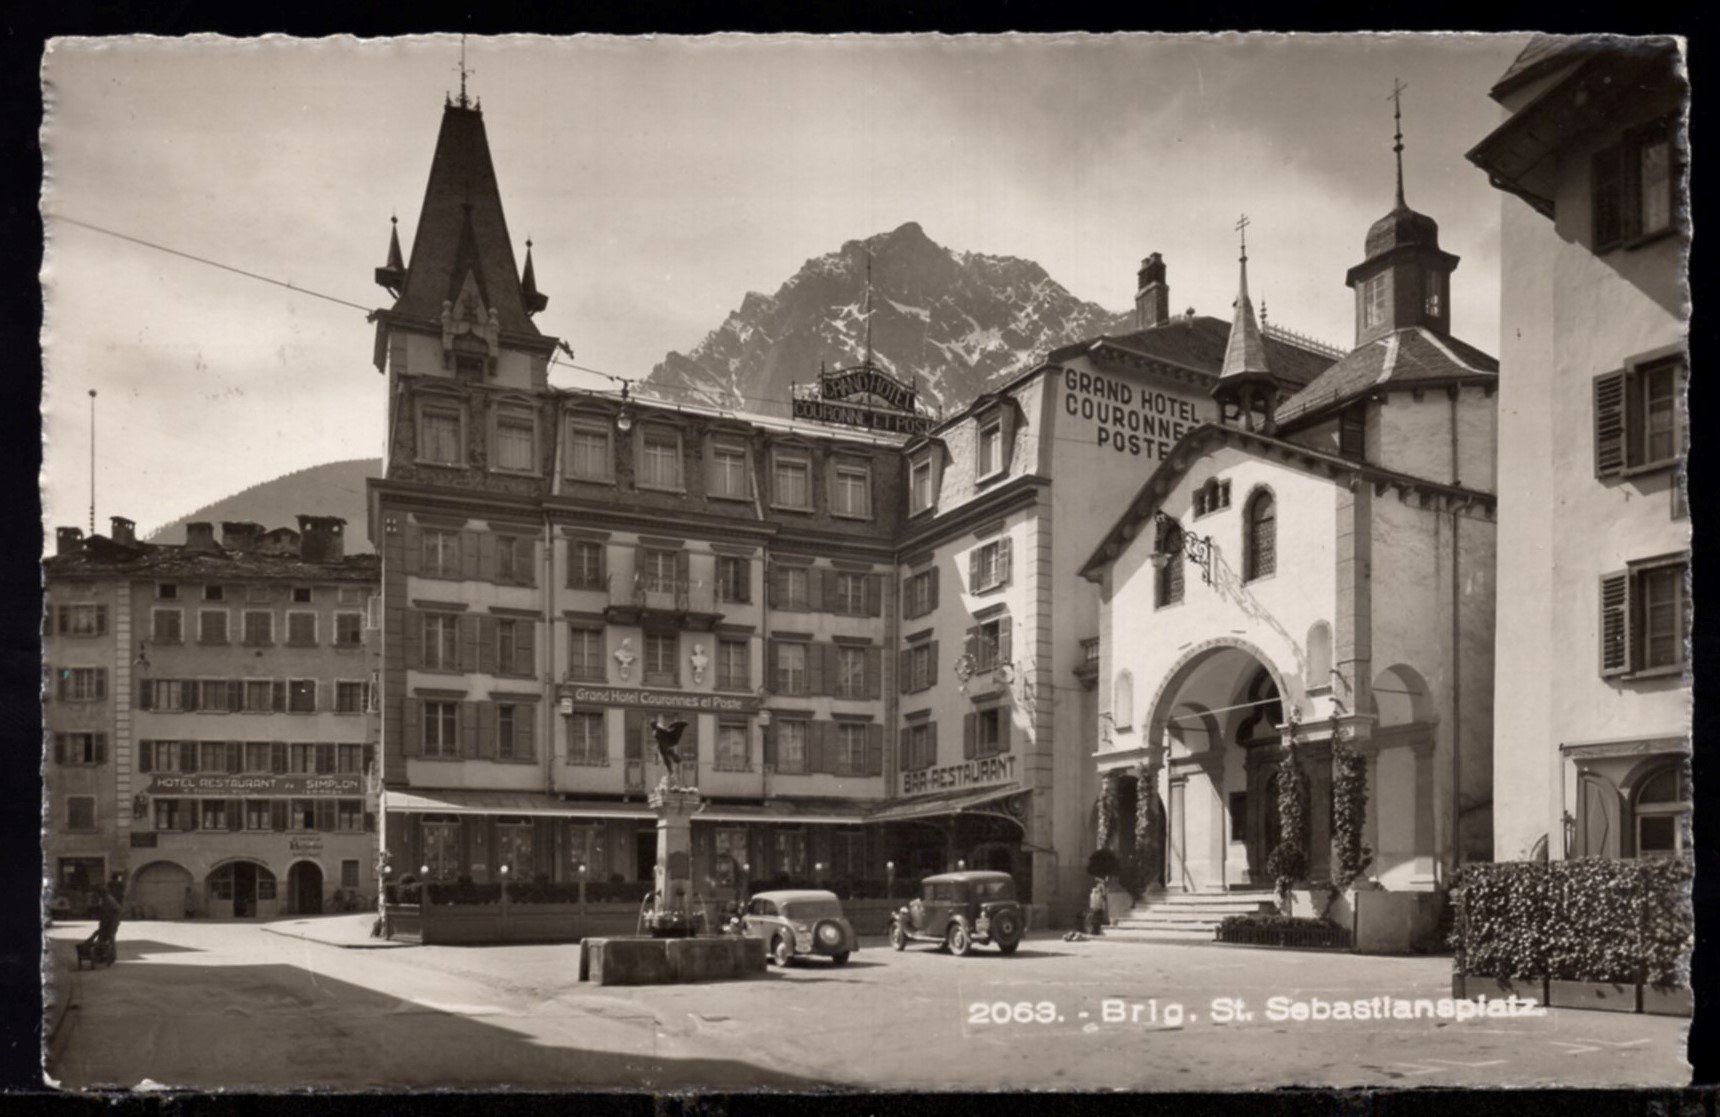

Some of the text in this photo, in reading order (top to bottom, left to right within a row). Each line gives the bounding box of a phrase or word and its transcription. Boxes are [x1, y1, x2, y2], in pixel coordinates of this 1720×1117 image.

[824, 374, 914, 412] GRAND HOTEL
[1065, 368, 1200, 424] GRAND HOTEL
[896, 414, 935, 436] POST
[1097, 425, 1170, 462] POSTE
[575, 687, 610, 703] Grand
[611, 690, 639, 705] Hotel
[157, 778, 196, 789] HOTEL
[199, 778, 278, 790] RESTAURANT
[305, 779, 359, 790] SIMPLON
[904, 755, 1016, 793] BAR RESTAURANT
